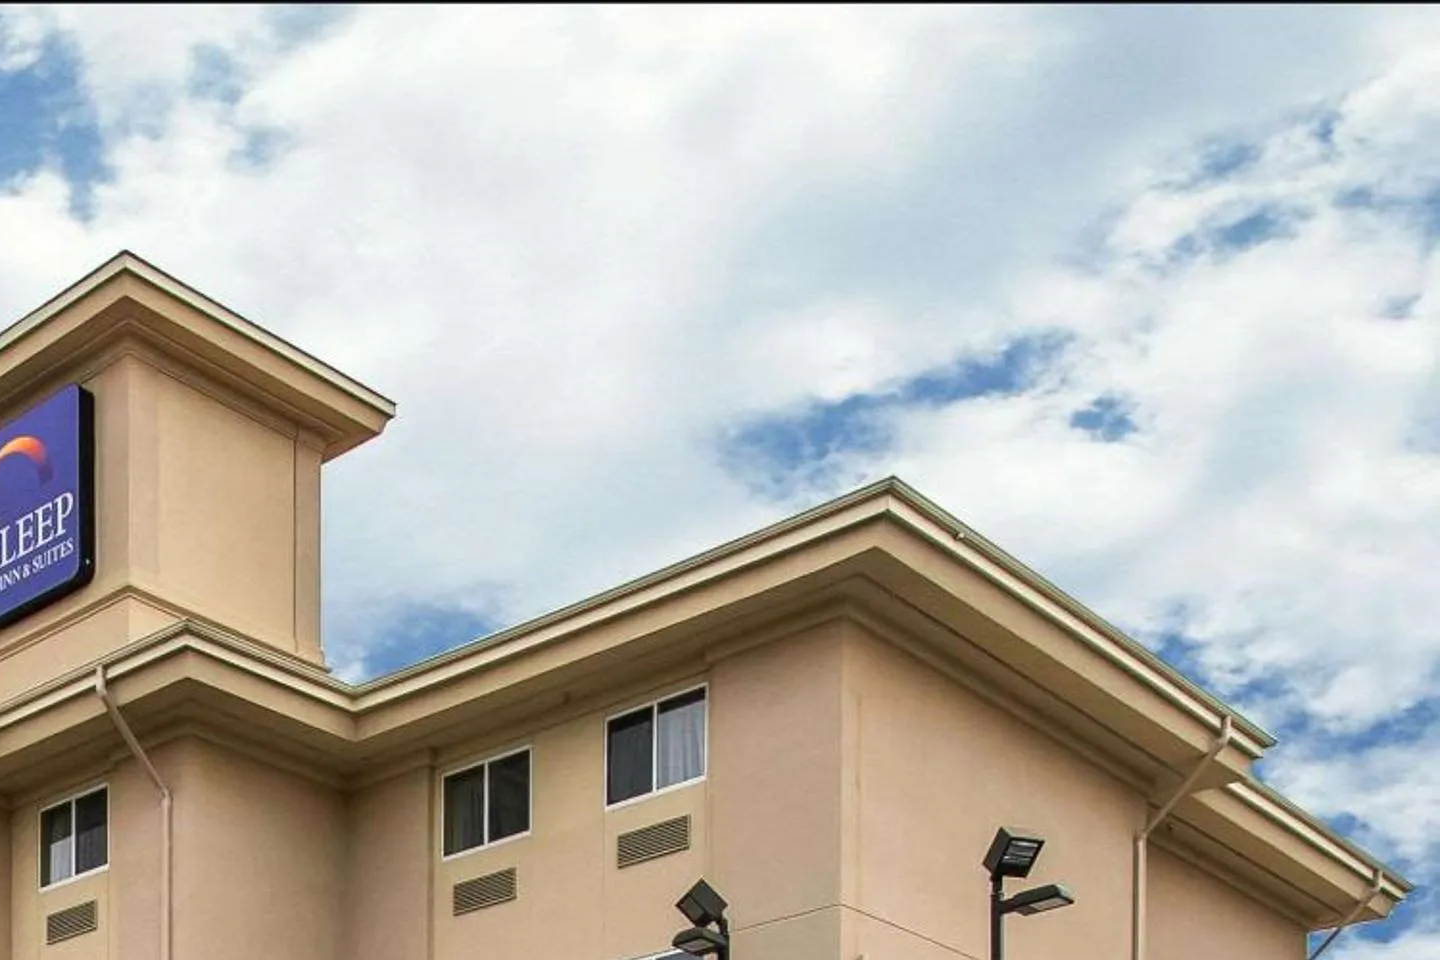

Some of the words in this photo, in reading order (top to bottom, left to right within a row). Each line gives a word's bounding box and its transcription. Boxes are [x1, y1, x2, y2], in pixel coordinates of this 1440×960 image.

[0, 565, 22, 592] INN
[22, 563, 31, 579] &
[32, 537, 75, 574] SUITES
